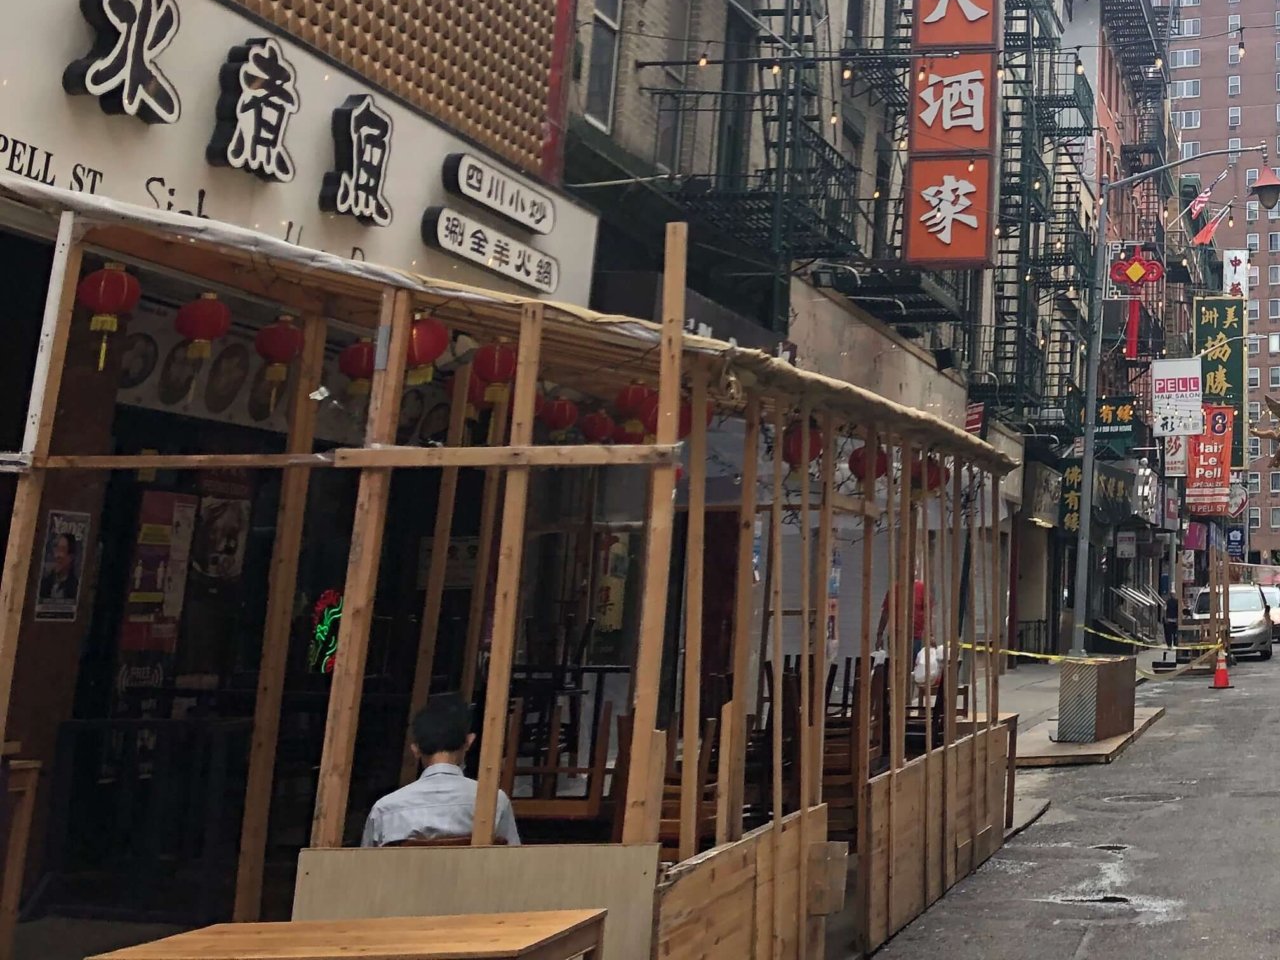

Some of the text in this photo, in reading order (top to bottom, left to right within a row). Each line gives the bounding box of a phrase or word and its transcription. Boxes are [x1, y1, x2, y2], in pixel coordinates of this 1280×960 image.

[465, 163, 548, 226] 四川小炒
[444, 215, 552, 287] 涮全羊火鍋
[1155, 378, 1199, 393] PELL
[1204, 330, 1233, 405] 協勝
[1195, 467, 1221, 479] Pell
[1199, 454, 1217, 466] Le
